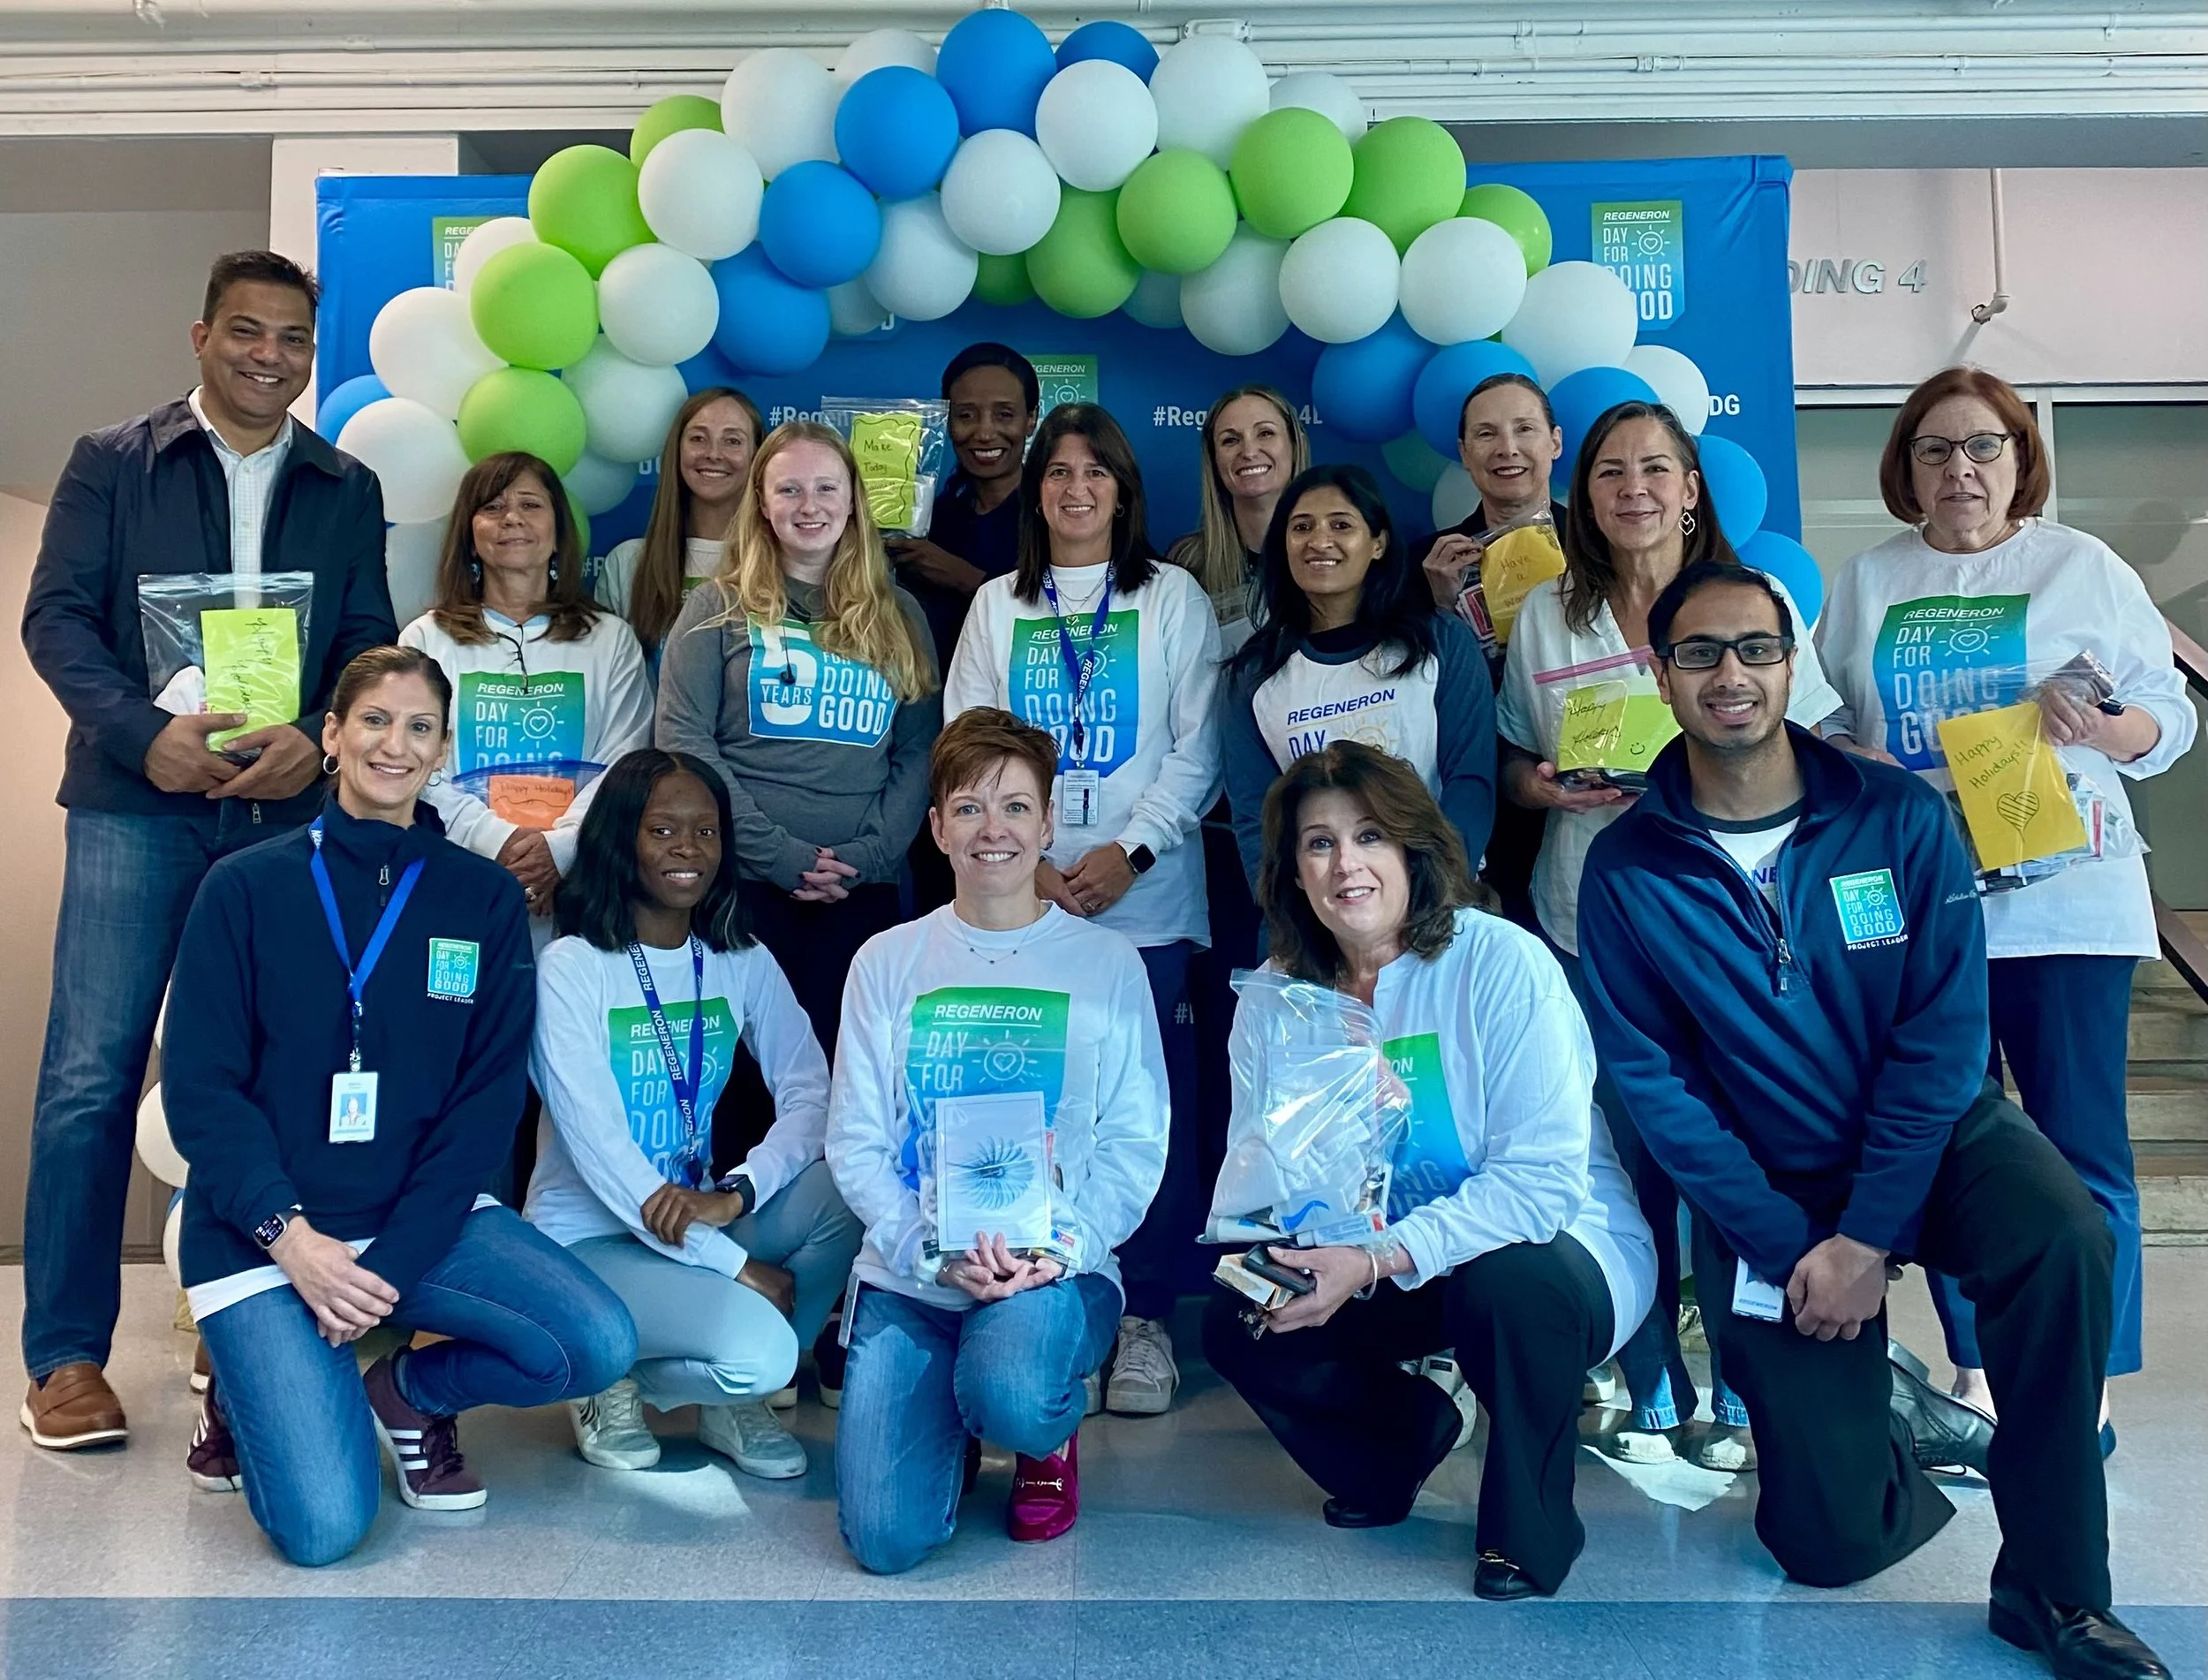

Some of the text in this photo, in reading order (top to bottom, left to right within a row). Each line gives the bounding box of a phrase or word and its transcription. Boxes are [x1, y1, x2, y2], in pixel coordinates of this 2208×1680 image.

[1603, 210, 1670, 221] REGENERON
[1603, 227, 1628, 244] DAY
[1603, 246, 1629, 263] FOR
[1898, 259, 1928, 293] 4
[864, 439, 892, 452] Make
[1903, 607, 2005, 620] REGENERON
[1895, 626, 1937, 646] DAY
[1026, 647, 1062, 666] DAY
[1893, 646, 1932, 669] FOR
[1024, 669, 1060, 690] FOR
[1894, 667, 2000, 710] DOING
[475, 701, 509, 723] DAY
[761, 685, 896, 736] YEARS GOOD
[1287, 688, 1395, 726] REGENERON
[475, 726, 509, 749] FOR
[1289, 730, 1326, 761] DAY
[1954, 735, 2003, 767] Happy
[1846, 901, 1864, 915] FOR
[1849, 908, 1894, 927] DOING
[1853, 919, 1896, 937] GOOD
[1847, 940, 1880, 951] PROJECT
[434, 980, 469, 993] GOOD
[435, 970, 470, 984] DOING
[934, 1003, 1042, 1021] REGENERON
[651, 1010, 683, 1081] REGENERON
[925, 1031, 969, 1059] DAY
[921, 1063, 964, 1092] FOR
[631, 1080, 668, 1107] FOR
